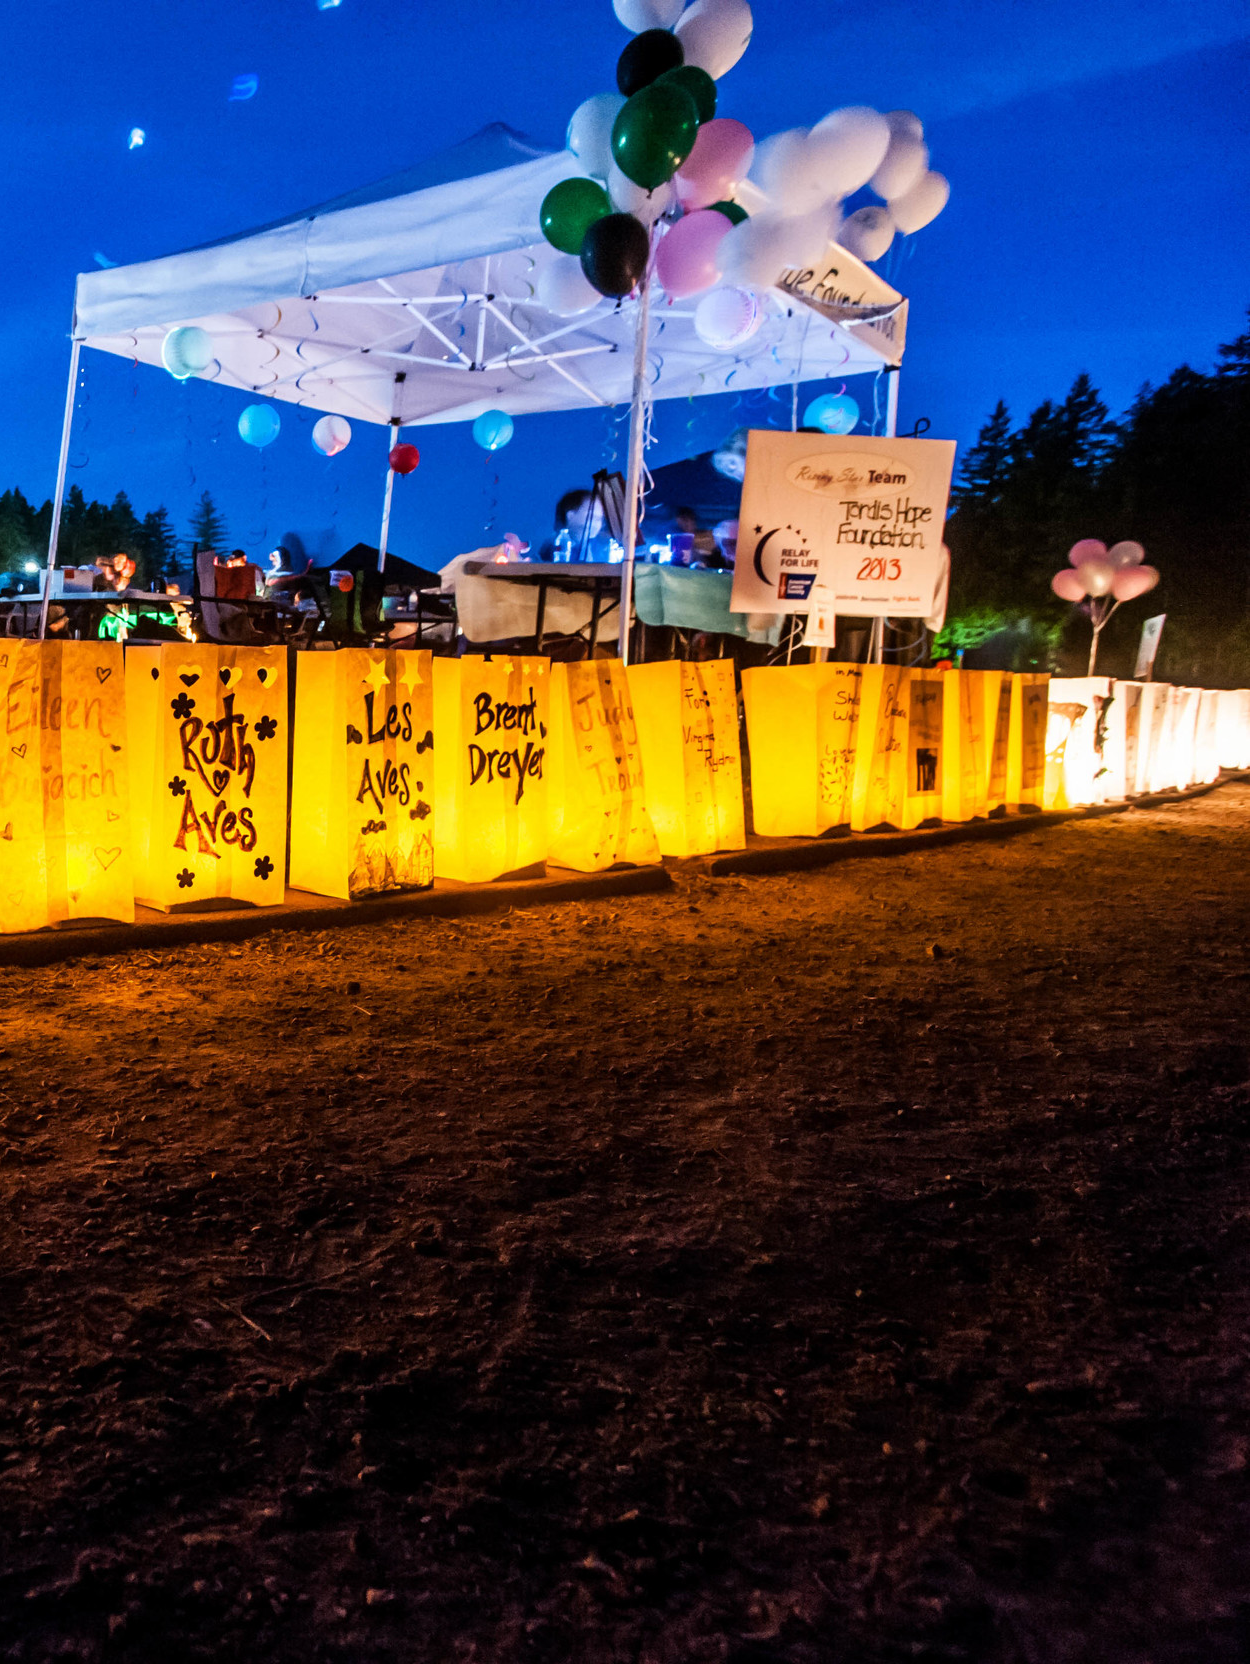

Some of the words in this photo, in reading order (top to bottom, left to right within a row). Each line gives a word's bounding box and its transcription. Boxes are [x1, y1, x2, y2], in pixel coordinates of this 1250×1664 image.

[868, 470, 907, 485] Team
[895, 496, 933, 529] Hope
[780, 558, 798, 567] FOR
[801, 559, 819, 568] LIFE
[782, 549, 811, 557] RELAY
[856, 556, 902, 581] 2013
[364, 691, 412, 744] Les
[473, 687, 537, 736] Brent
[179, 693, 256, 798] Ruth
[356, 758, 410, 815] Aves
[469, 742, 545, 805] Dreyer
[173, 790, 257, 859] Aves
